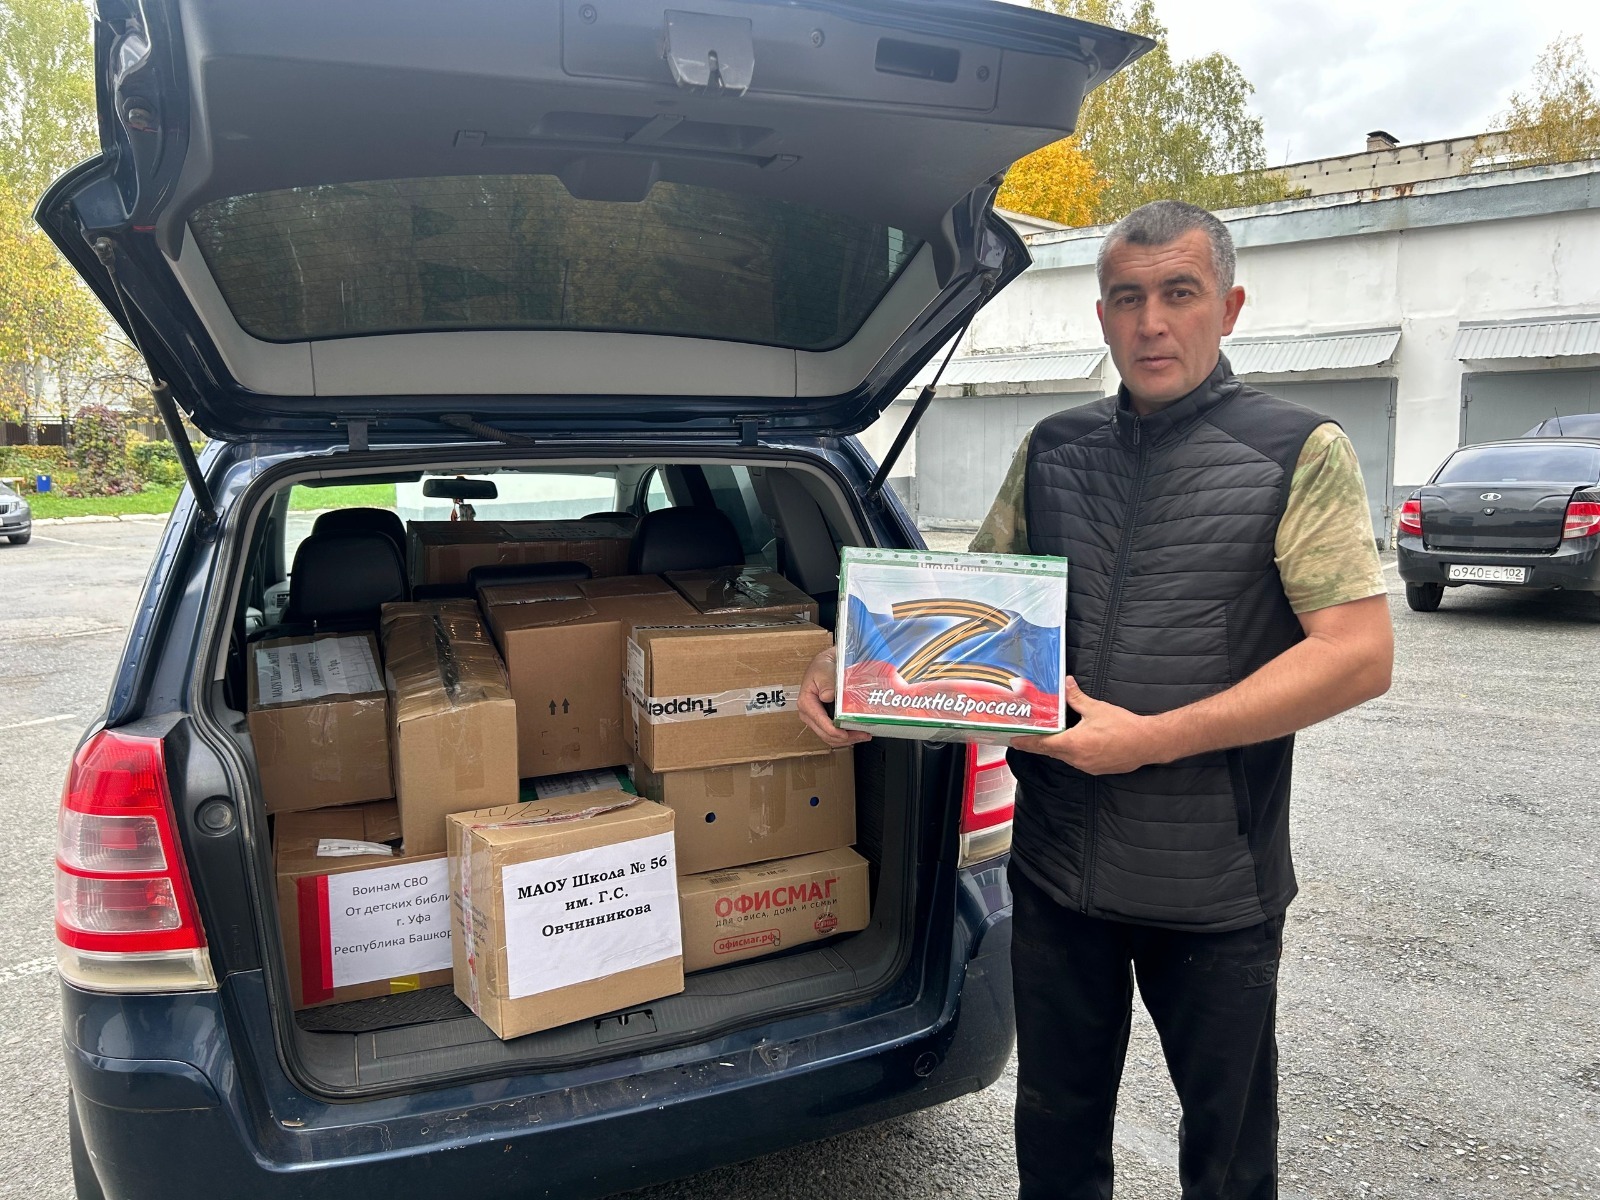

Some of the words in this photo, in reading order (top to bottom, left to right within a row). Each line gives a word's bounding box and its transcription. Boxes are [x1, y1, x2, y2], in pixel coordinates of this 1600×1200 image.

[1503, 568, 1522, 578] 102
[891, 597, 1021, 693] Z
[867, 689, 1032, 717] #СвоихНеБросаем
[352, 882, 400, 896] Воинам
[403, 876, 428, 888] СВО
[517, 878, 568, 900] МАОУ
[572, 868, 625, 888] Школа
[630, 861, 646, 875] №
[650, 855, 668, 870] 56
[345, 907, 361, 917] От
[364, 899, 412, 915] детских
[565, 897, 593, 911] им.
[598, 887, 629, 904] Г.С.
[714, 878, 837, 918] ОФИСМАГ
[773, 906, 797, 916] ДОМА
[810, 898, 838, 909] СЕМЬИ
[396, 918, 405, 926] г.
[408, 914, 431, 925] Уфа
[542, 903, 652, 937] Овчинникова
[334, 937, 405, 955] Республика
[719, 932, 776, 951] офисмаг.рф
